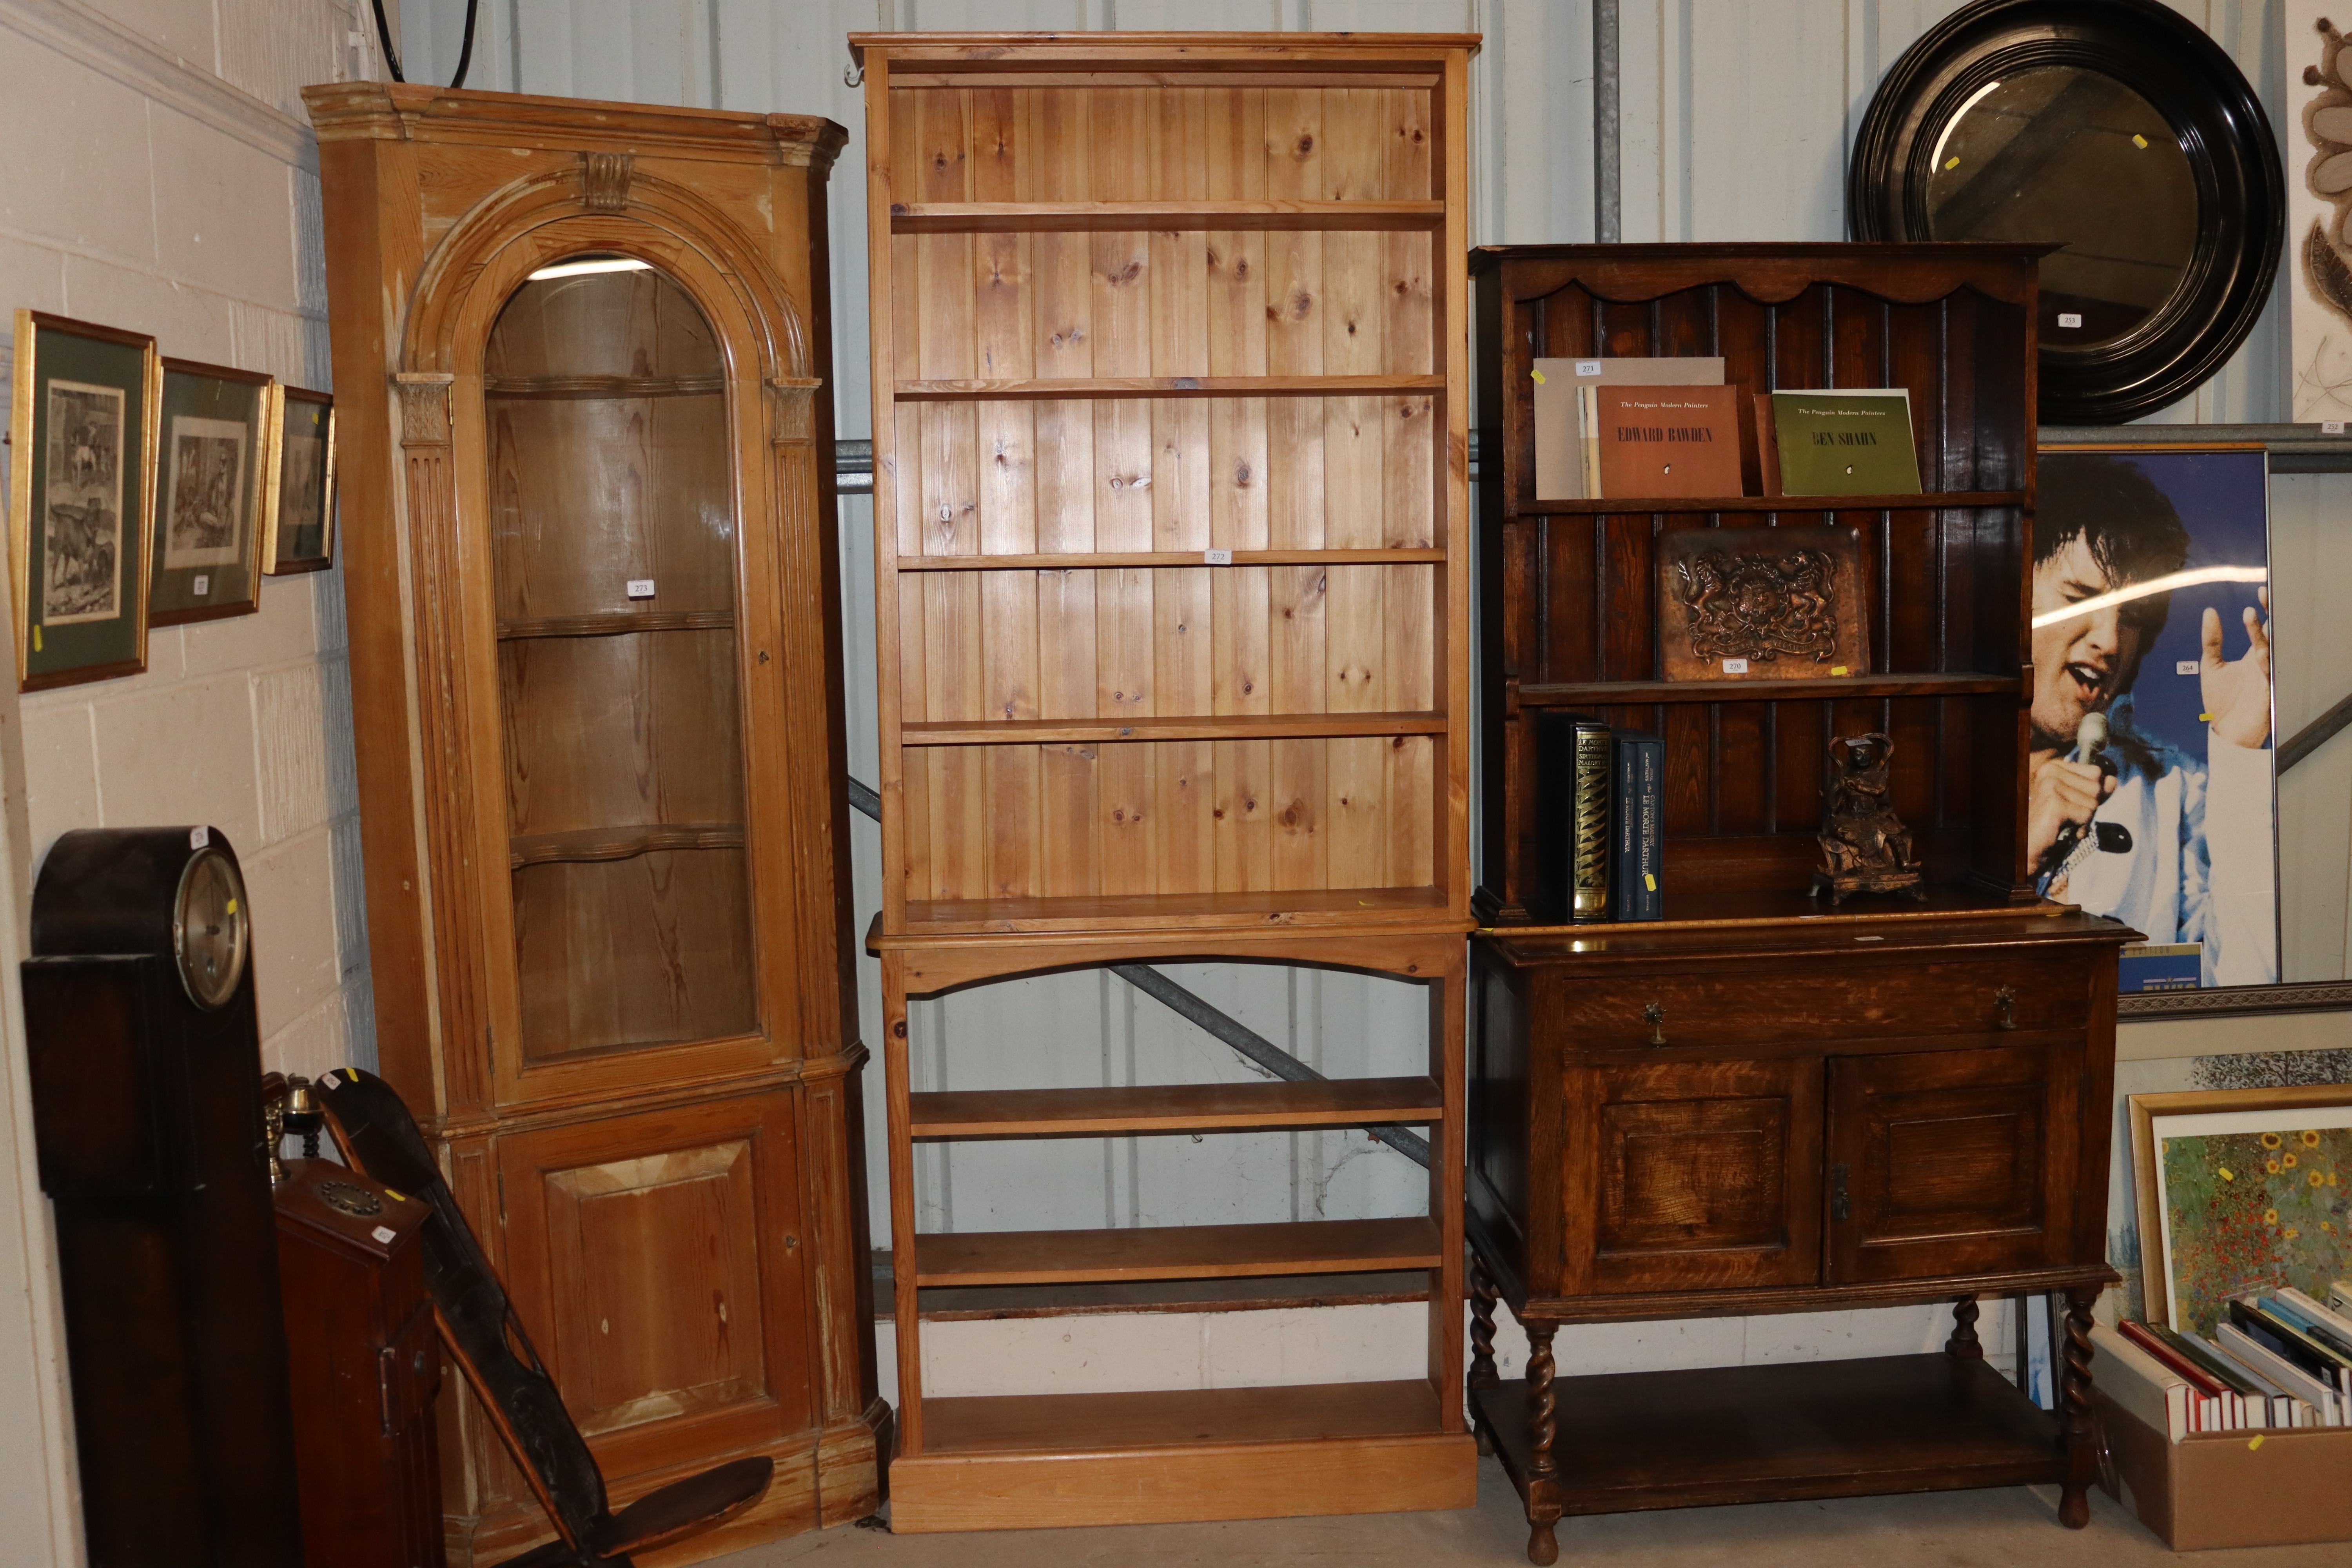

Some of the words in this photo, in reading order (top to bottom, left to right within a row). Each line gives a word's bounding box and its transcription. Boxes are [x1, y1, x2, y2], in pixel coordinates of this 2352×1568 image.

[1617, 426, 1663, 442] EDWARD
[1668, 427, 1713, 442] BAWDEN
[1812, 432, 1834, 445] BEN
[1838, 432, 1877, 445] SHAHN
[1643, 795, 1650, 804] LE
